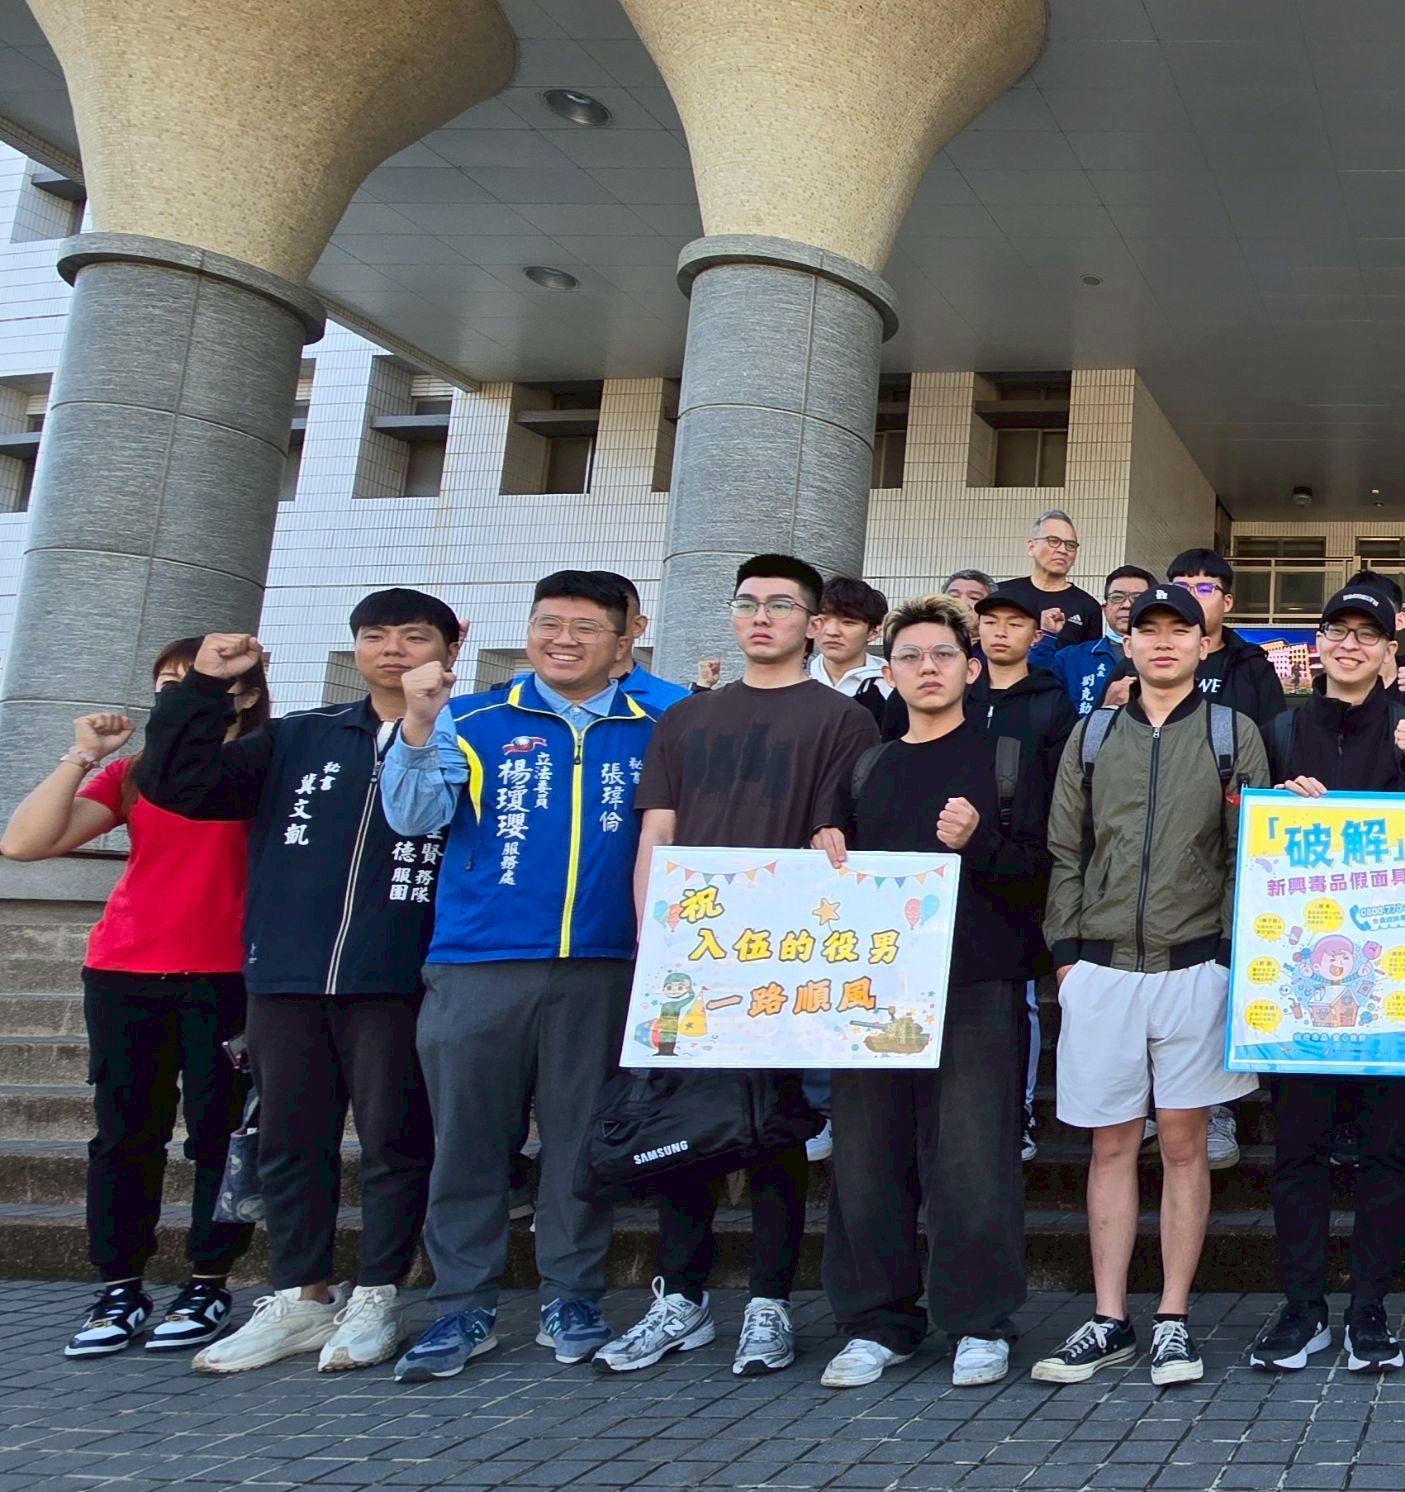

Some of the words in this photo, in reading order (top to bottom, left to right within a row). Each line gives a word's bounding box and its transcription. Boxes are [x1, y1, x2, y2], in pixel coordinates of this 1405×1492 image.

[533, 752, 553, 809] 立法委員
[1267, 817, 1405, 869] 「破解」
[679, 885, 725, 923] 祝
[688, 928, 901, 965] 入伍的役男
[705, 976, 877, 1018] 一路順風
[633, 1140, 689, 1165] SAMSUNG
